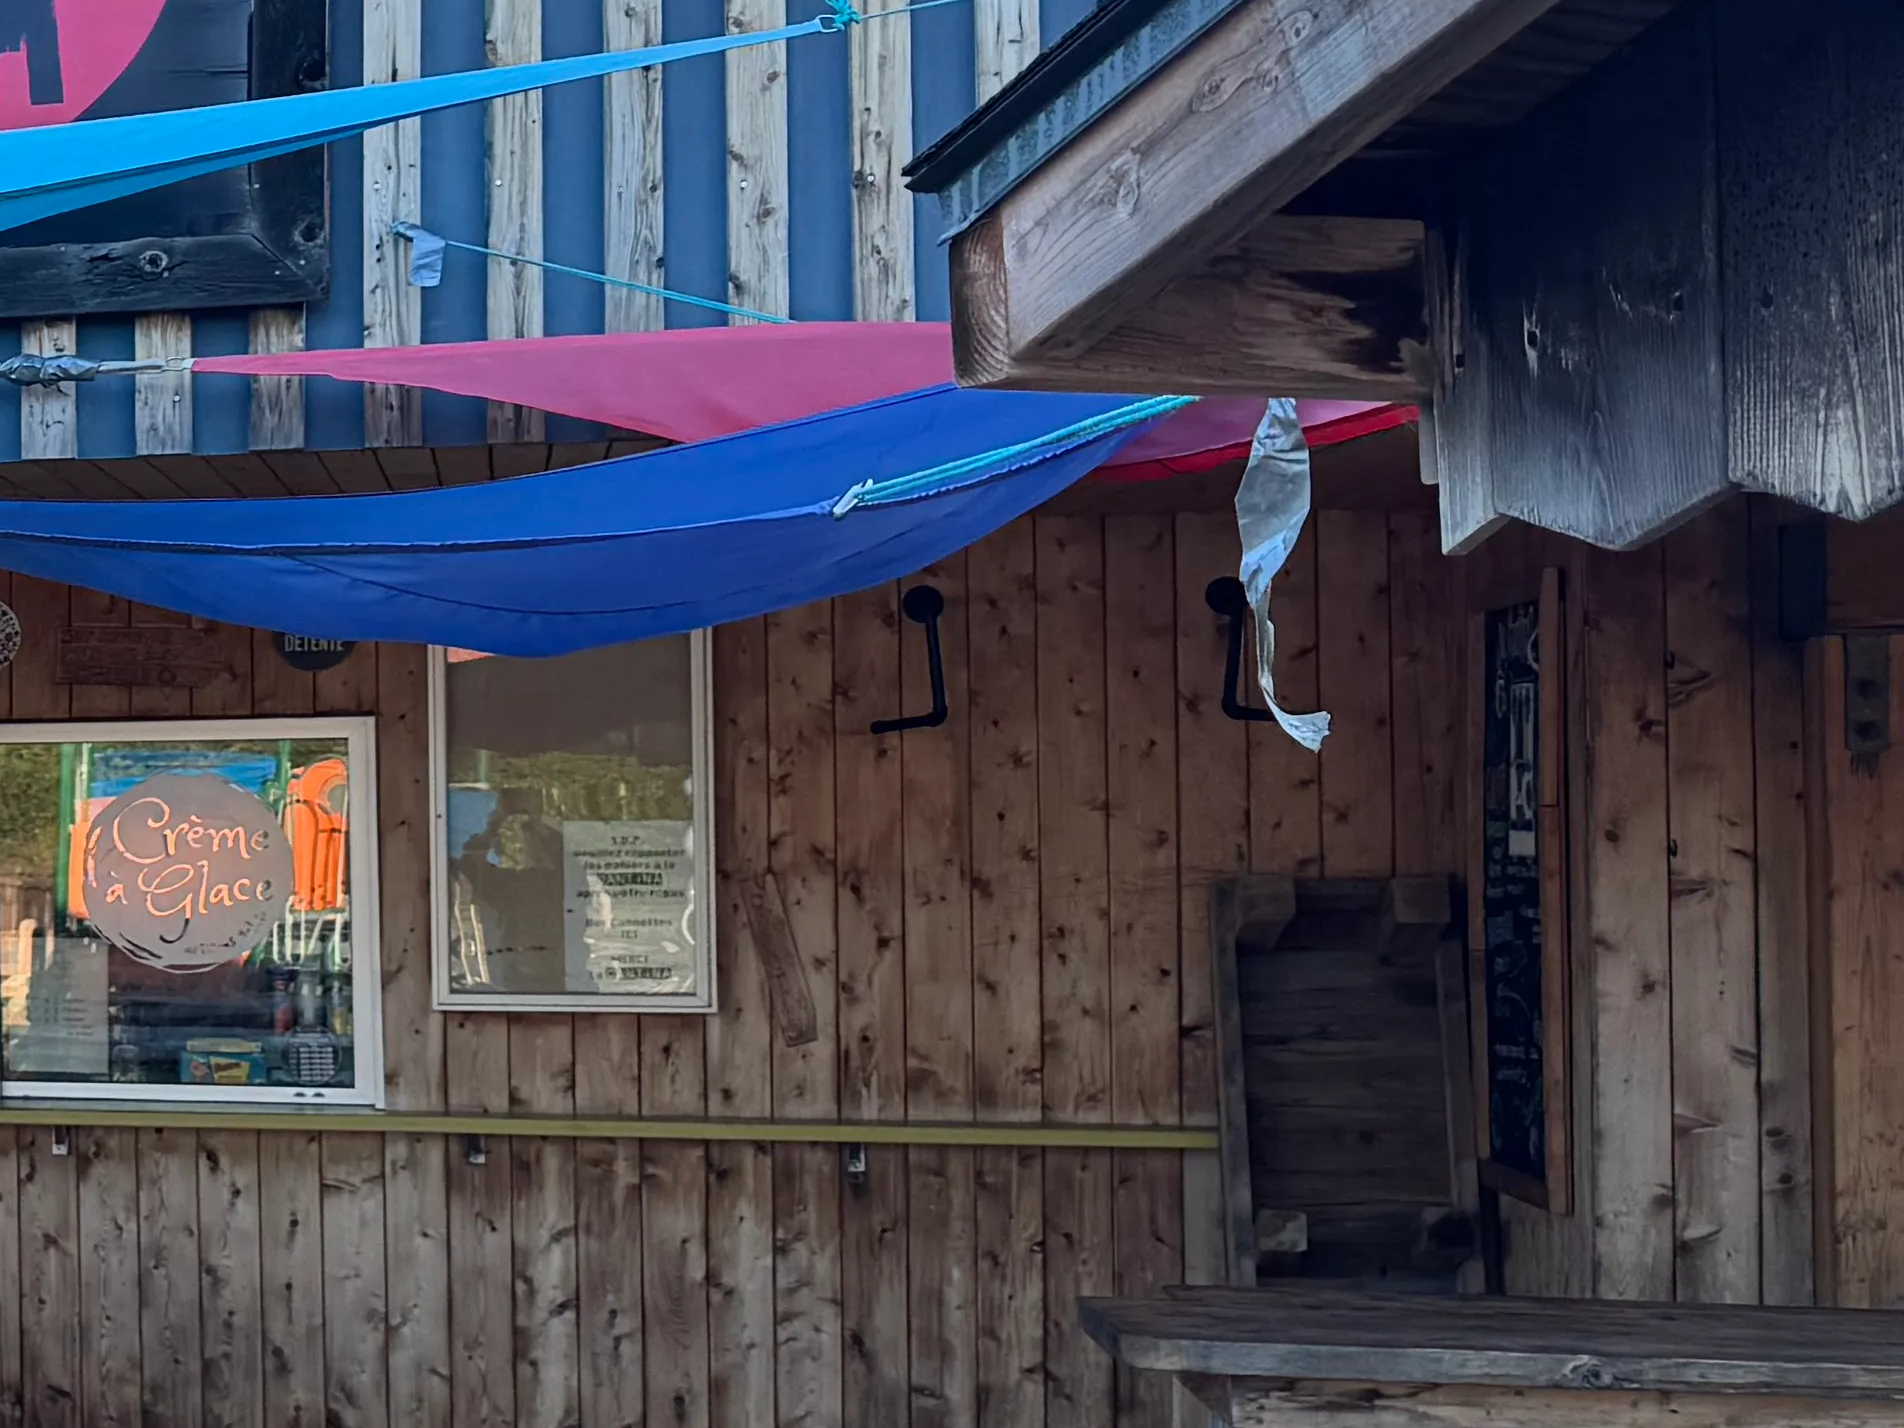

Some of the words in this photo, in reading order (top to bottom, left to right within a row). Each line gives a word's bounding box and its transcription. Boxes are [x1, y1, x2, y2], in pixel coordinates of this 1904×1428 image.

[112, 796, 270, 864] Crème
[105, 871, 129, 905] à
[137, 859, 274, 944] Glace
[593, 872, 663, 886] ANTINA
